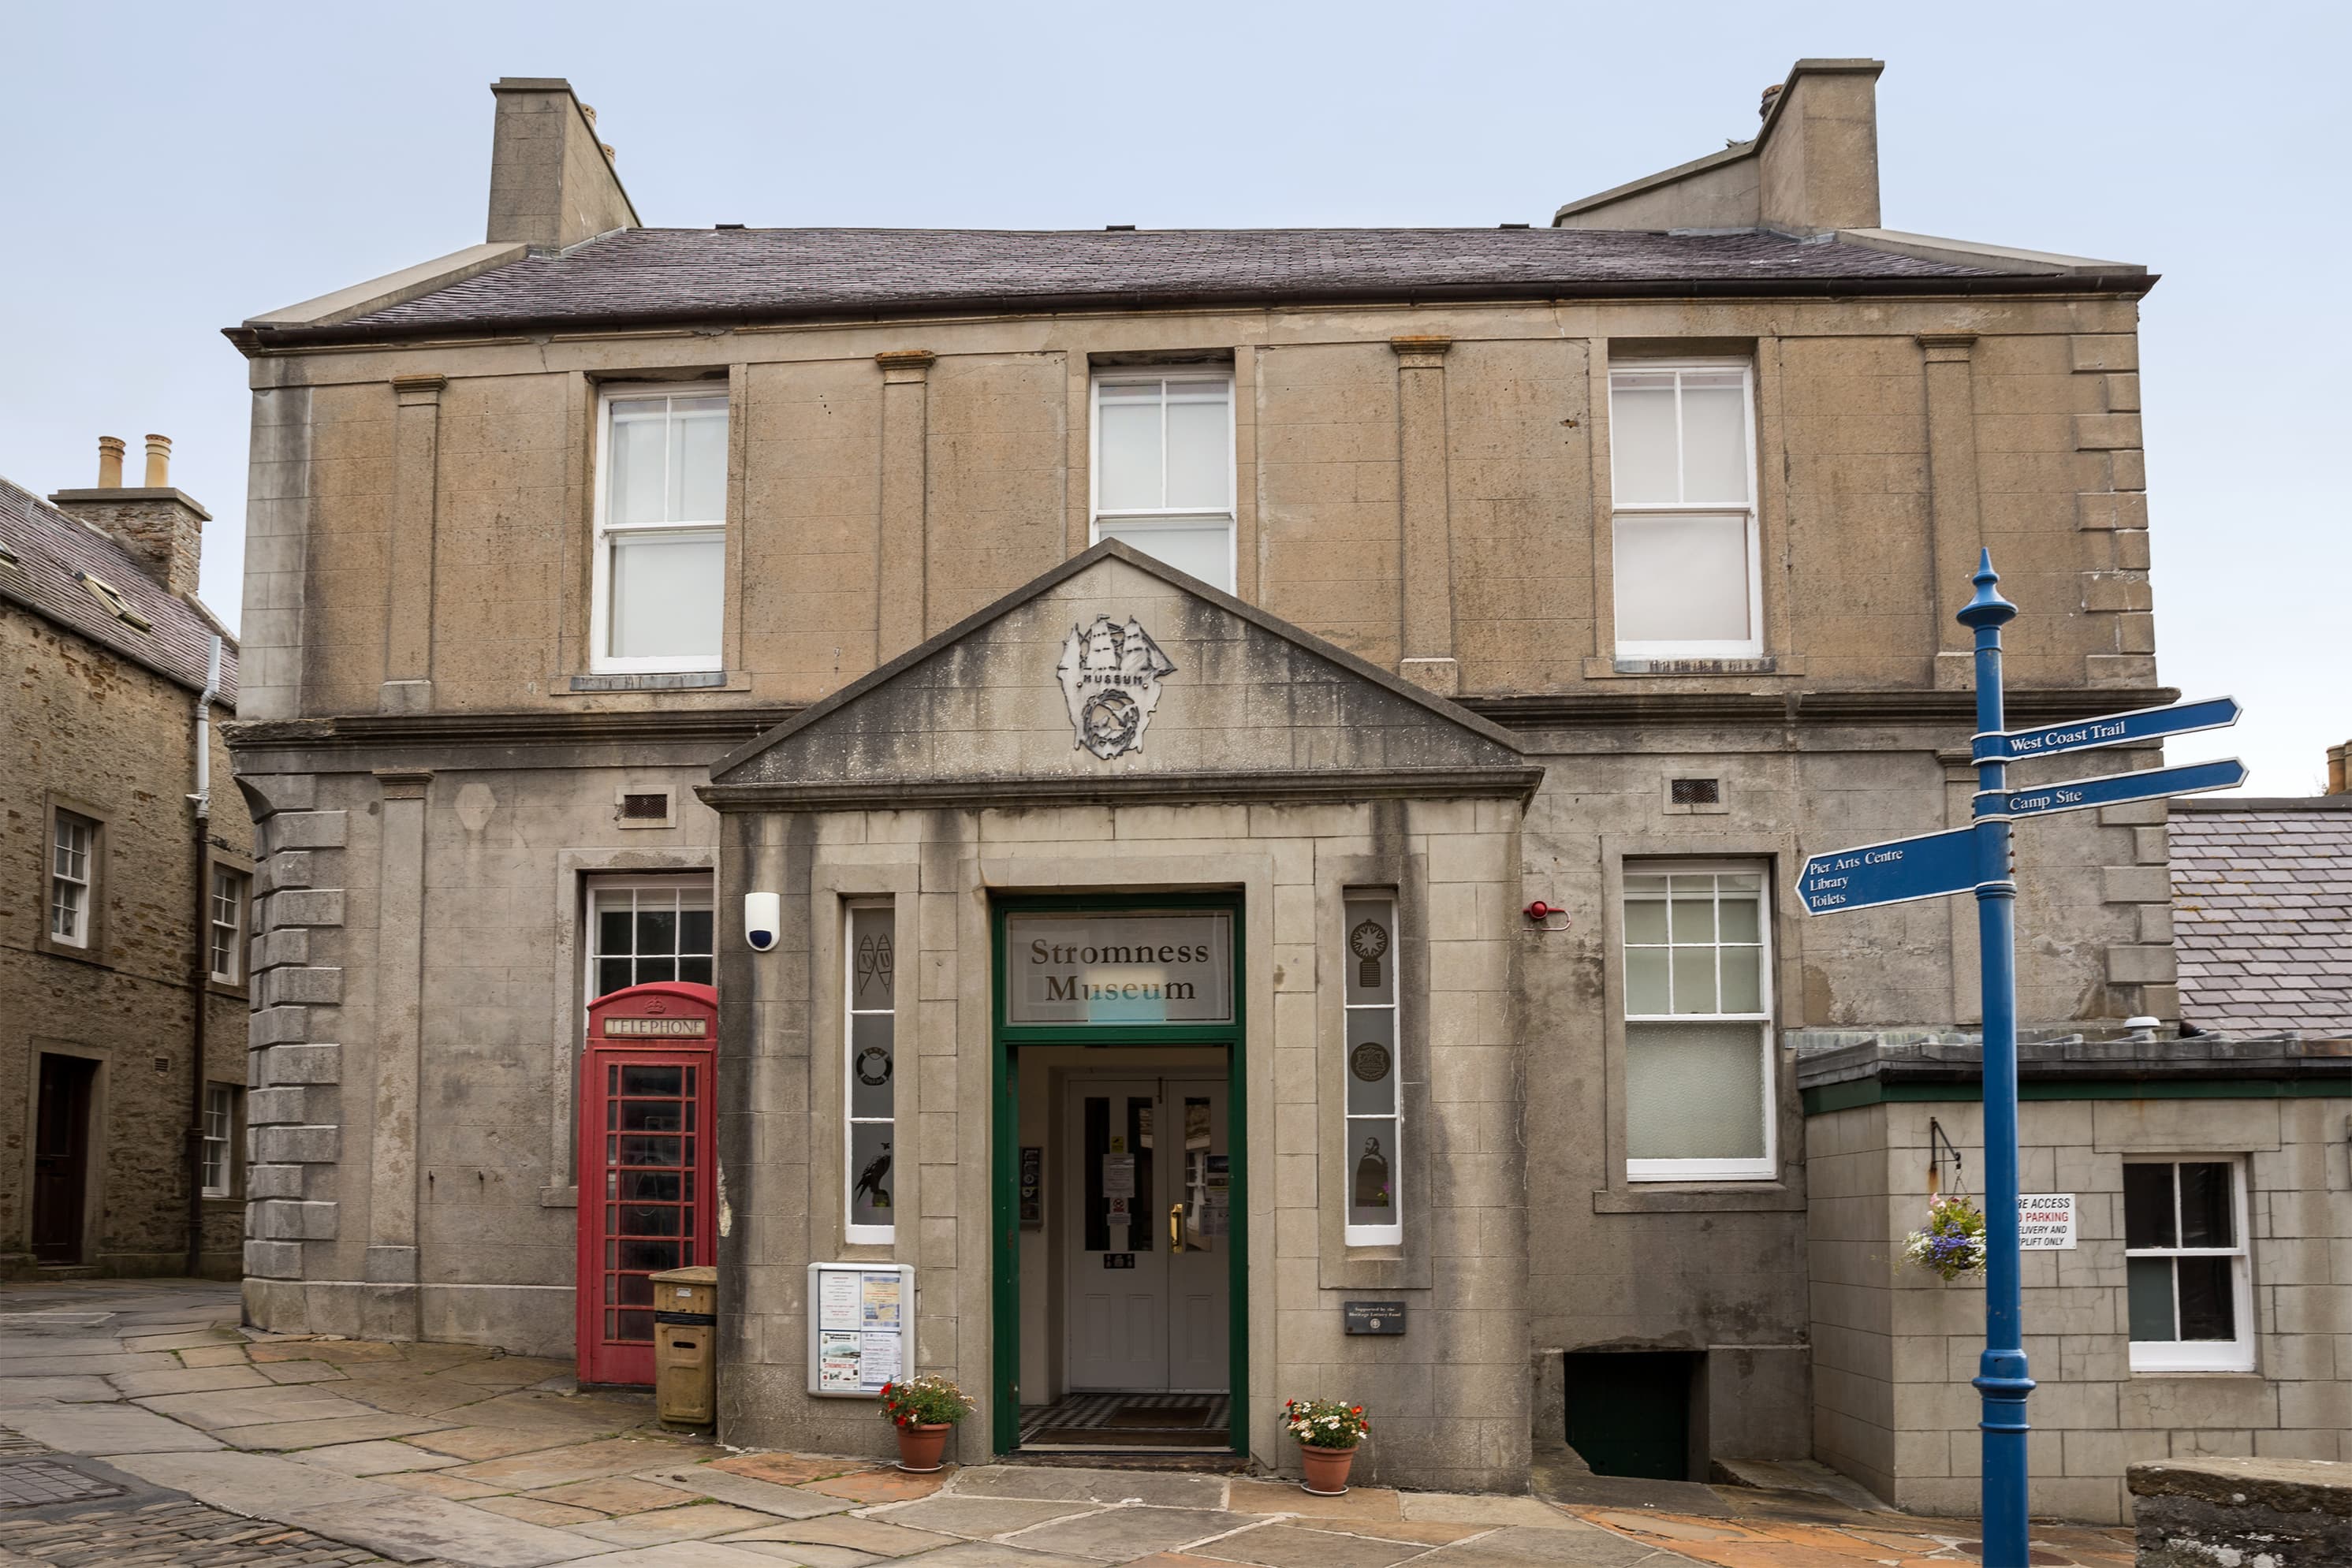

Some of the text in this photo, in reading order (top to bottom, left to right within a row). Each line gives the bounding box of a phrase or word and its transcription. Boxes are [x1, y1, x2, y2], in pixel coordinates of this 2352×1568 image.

[1083, 674, 1142, 685] MUSEUM
[2010, 721, 2126, 750] West Coast Trail
[2009, 790, 2082, 810] Camp Site
[1810, 851, 1903, 875] Pier Arts Centre
[1810, 877, 1849, 892] Library
[1810, 894, 1846, 907] Toilets
[1031, 938, 1210, 965] Stromness
[1045, 975, 1196, 1001] Museum
[610, 1019, 703, 1034] TELEPHONE
[2031, 1198, 2071, 1209] ACCESS
[2026, 1212, 2069, 1222] PARKING
[2018, 1225, 2067, 1235] ELIVERY AND
[2044, 1237, 2065, 1246] ONLY
